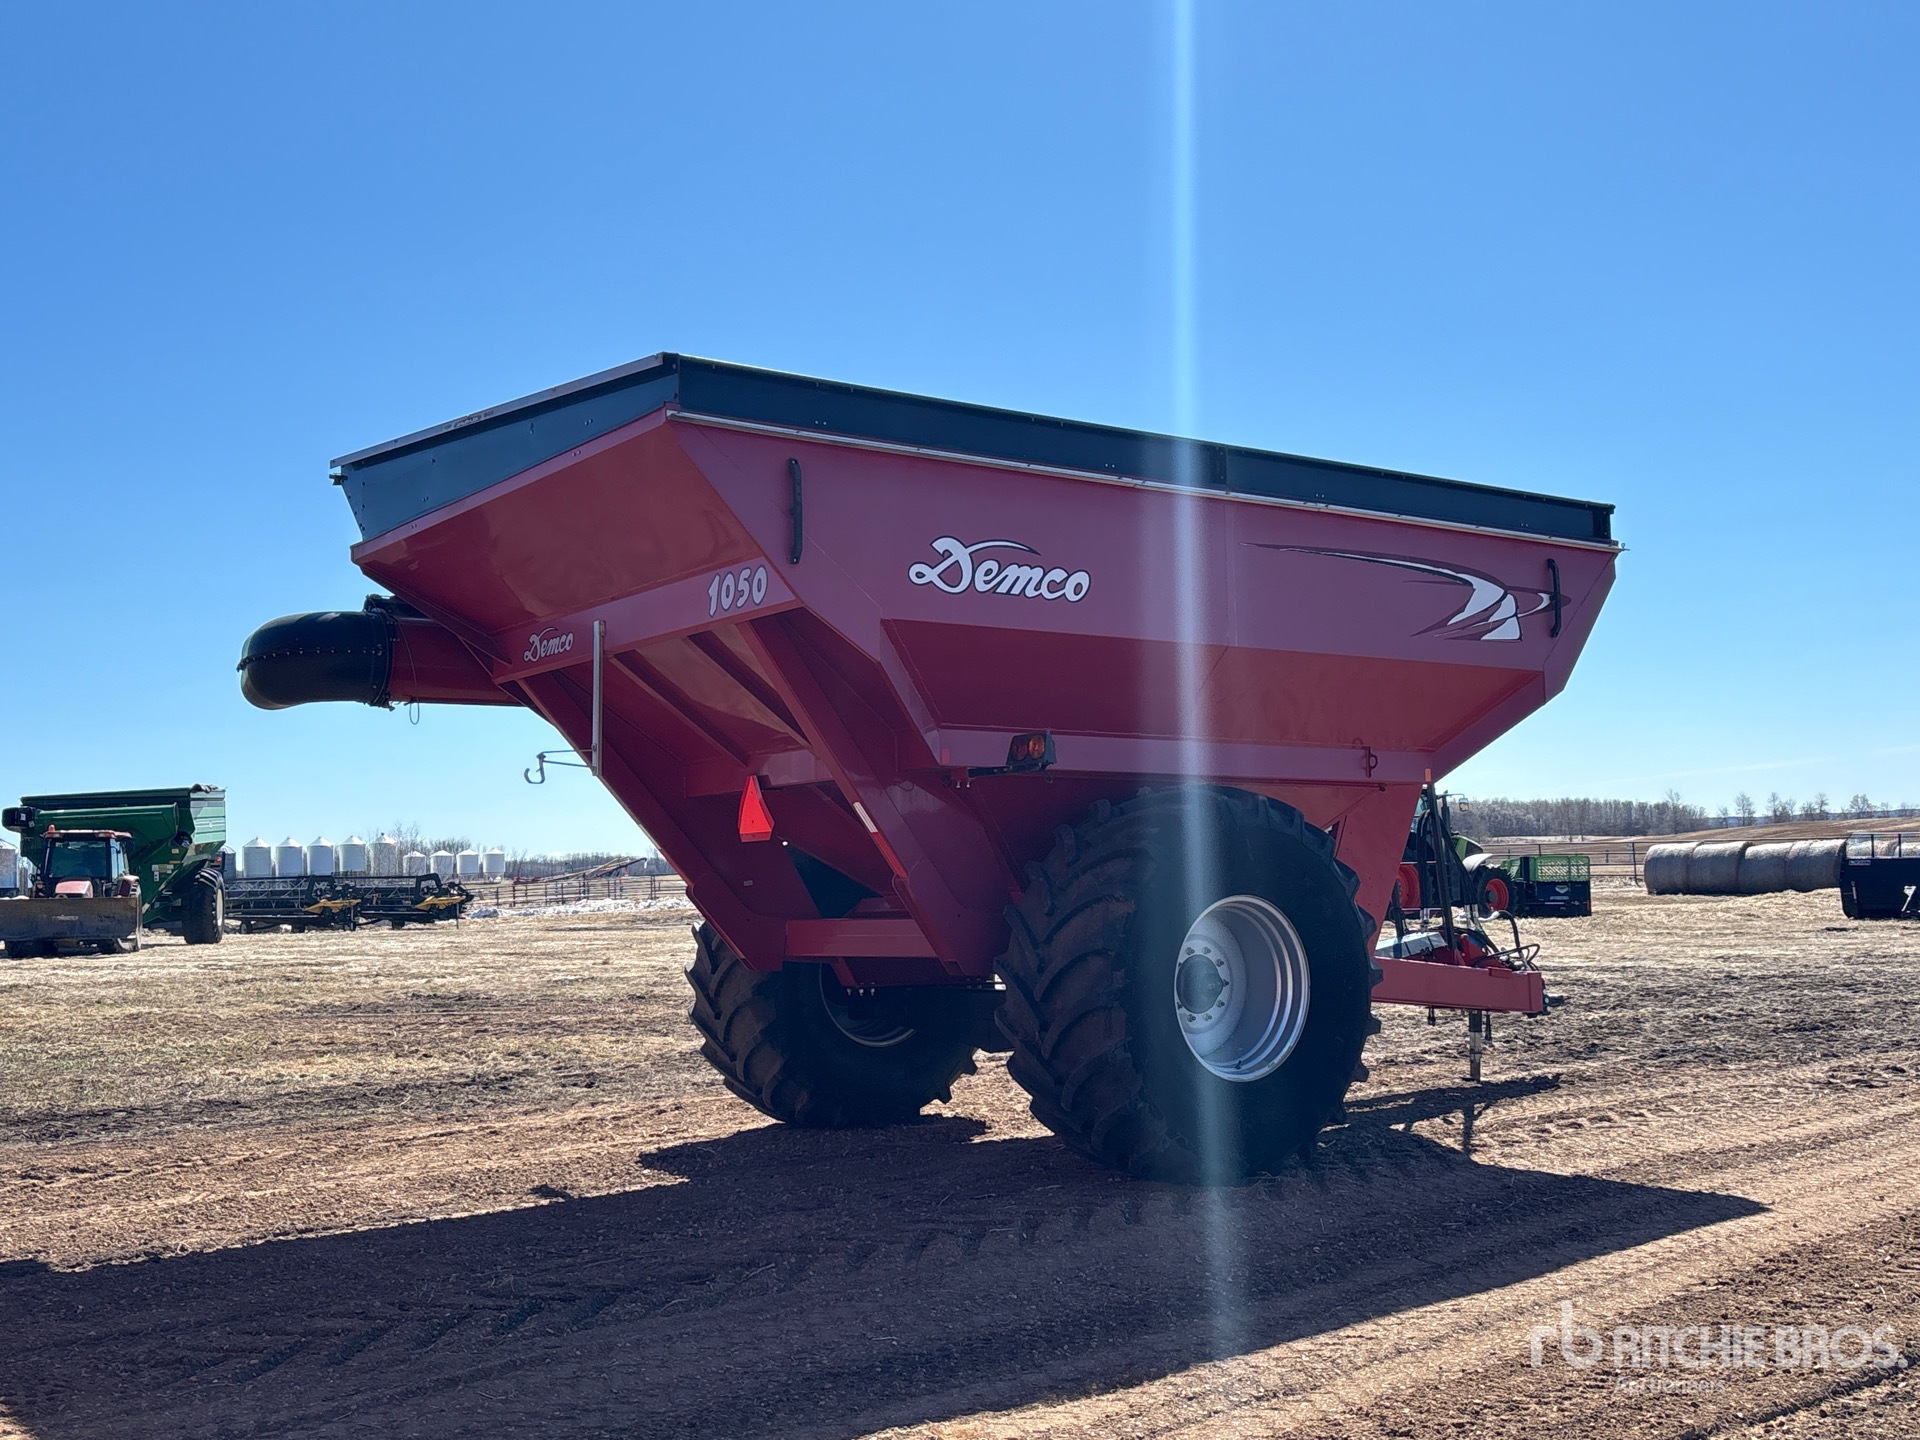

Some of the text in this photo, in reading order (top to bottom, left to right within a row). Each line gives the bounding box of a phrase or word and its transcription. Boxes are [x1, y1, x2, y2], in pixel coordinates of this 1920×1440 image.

[708, 565, 768, 617] 1050
[908, 535, 1091, 603] Demco
[523, 627, 574, 663] Demco
